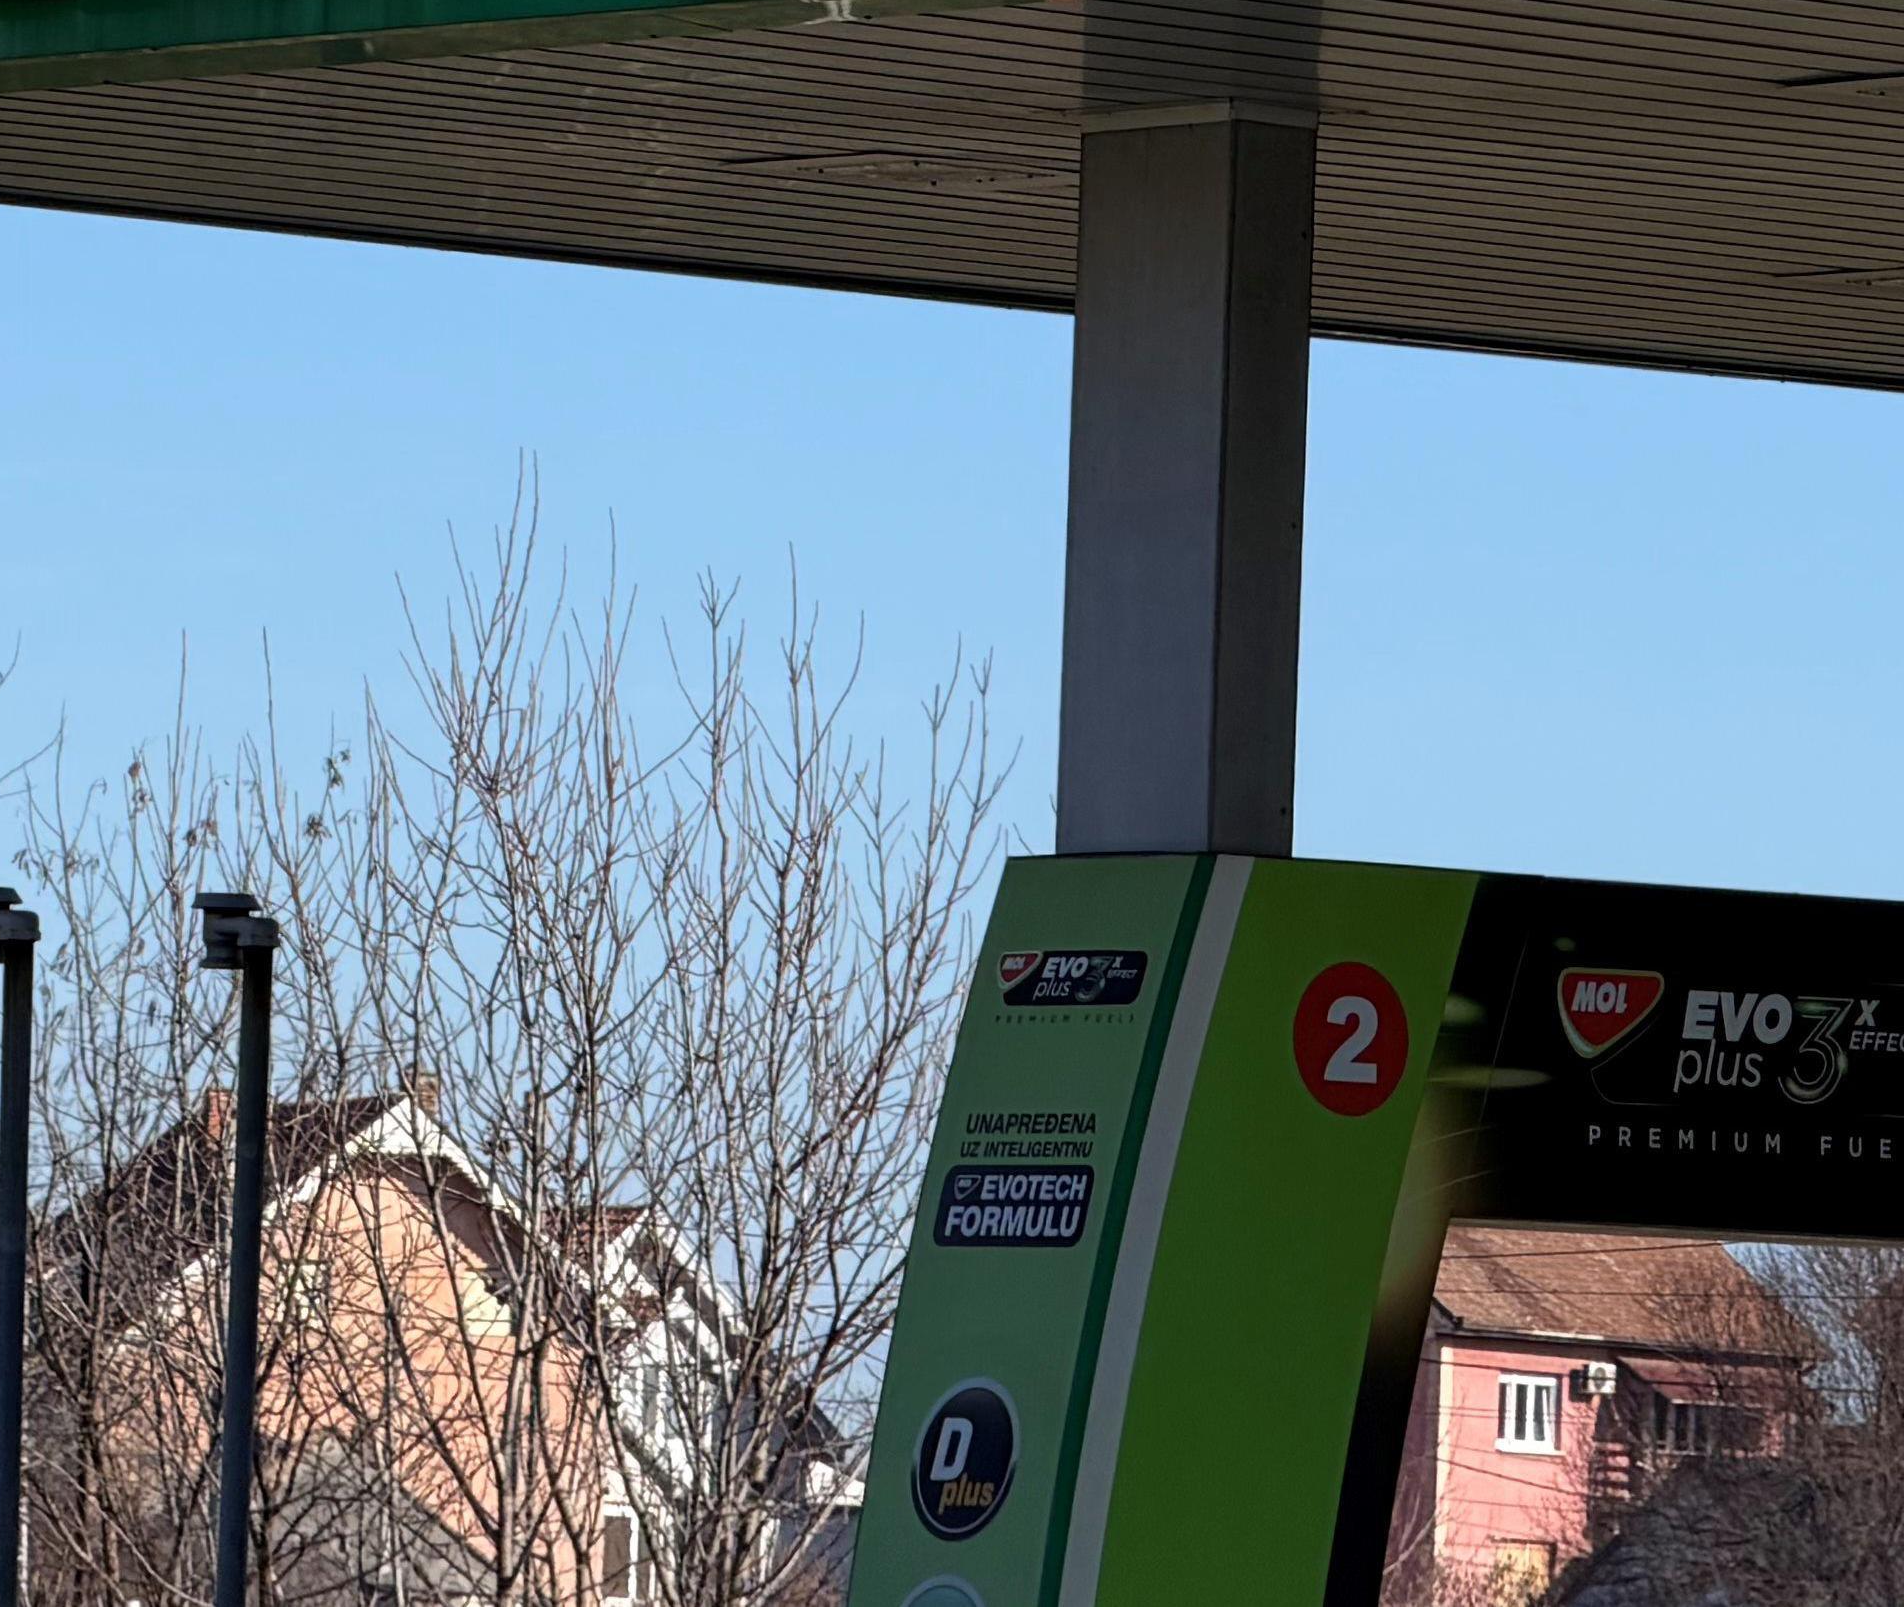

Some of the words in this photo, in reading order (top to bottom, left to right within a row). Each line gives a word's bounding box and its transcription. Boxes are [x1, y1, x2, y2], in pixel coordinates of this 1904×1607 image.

[1041, 956, 1089, 979] EVO
[1032, 977, 1073, 1002] plus
[1570, 980, 1629, 1014] MOL
[1323, 995, 1379, 1084] 2
[1681, 989, 1794, 1045] EVO
[1777, 994, 1855, 1105] 3
[1854, 998, 1881, 1028] X
[1673, 1038, 1765, 1094] plus
[966, 1113, 1096, 1134] UNAPREĐENA
[1587, 1124, 1782, 1156] PREMIUM
[960, 1141, 983, 1158] UZ
[983, 1141, 1094, 1158] INTELIGENTNU
[980, 1174, 1089, 1201] EVOTECH
[944, 1205, 1082, 1238] FORMULU
[930, 1417, 974, 1481] D
[937, 1472, 994, 1515] plus
